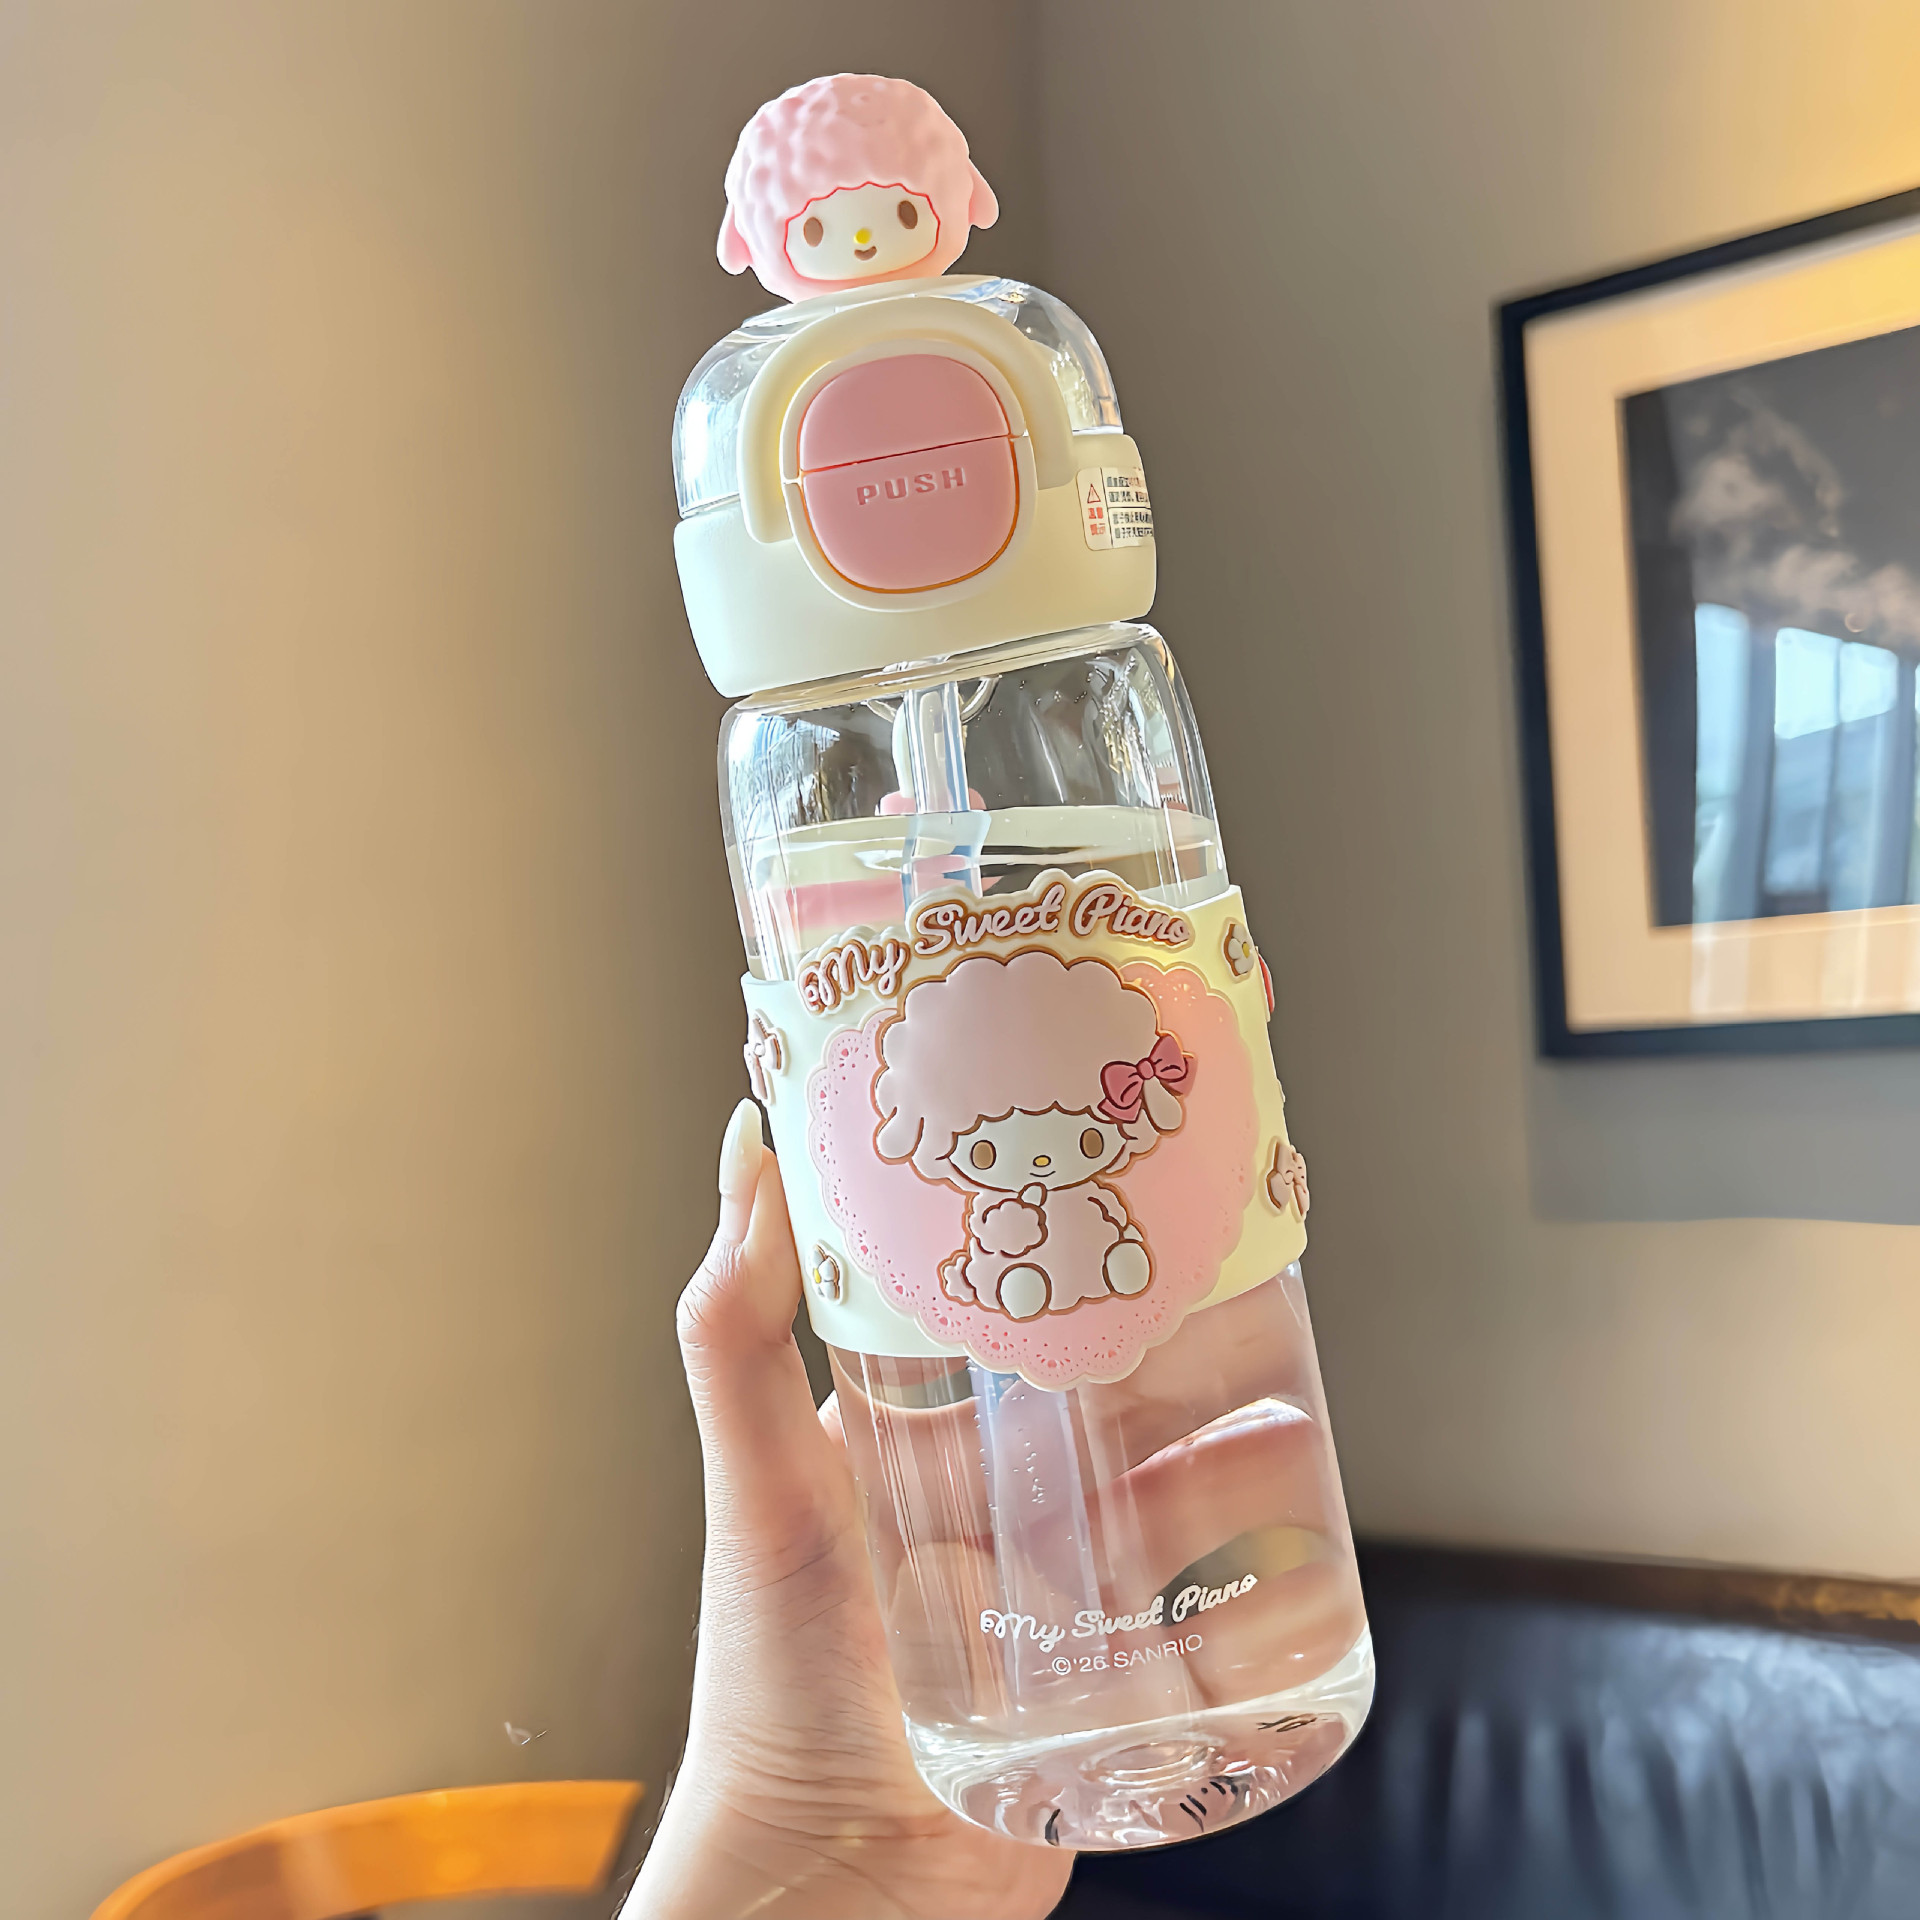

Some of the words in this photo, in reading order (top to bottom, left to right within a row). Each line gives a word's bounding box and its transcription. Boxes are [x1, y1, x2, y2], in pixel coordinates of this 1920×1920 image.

[857, 467, 966, 505] PUSH
[798, 938, 908, 1014] My
[913, 882, 1067, 957] Sweet
[1072, 883, 1192, 946] Piano
[980, 1609, 1065, 1653] My
[1071, 1595, 1164, 1638] Sweet
[1171, 1573, 1258, 1622] Piano
[1113, 1634, 1203, 1668] SANRIO
